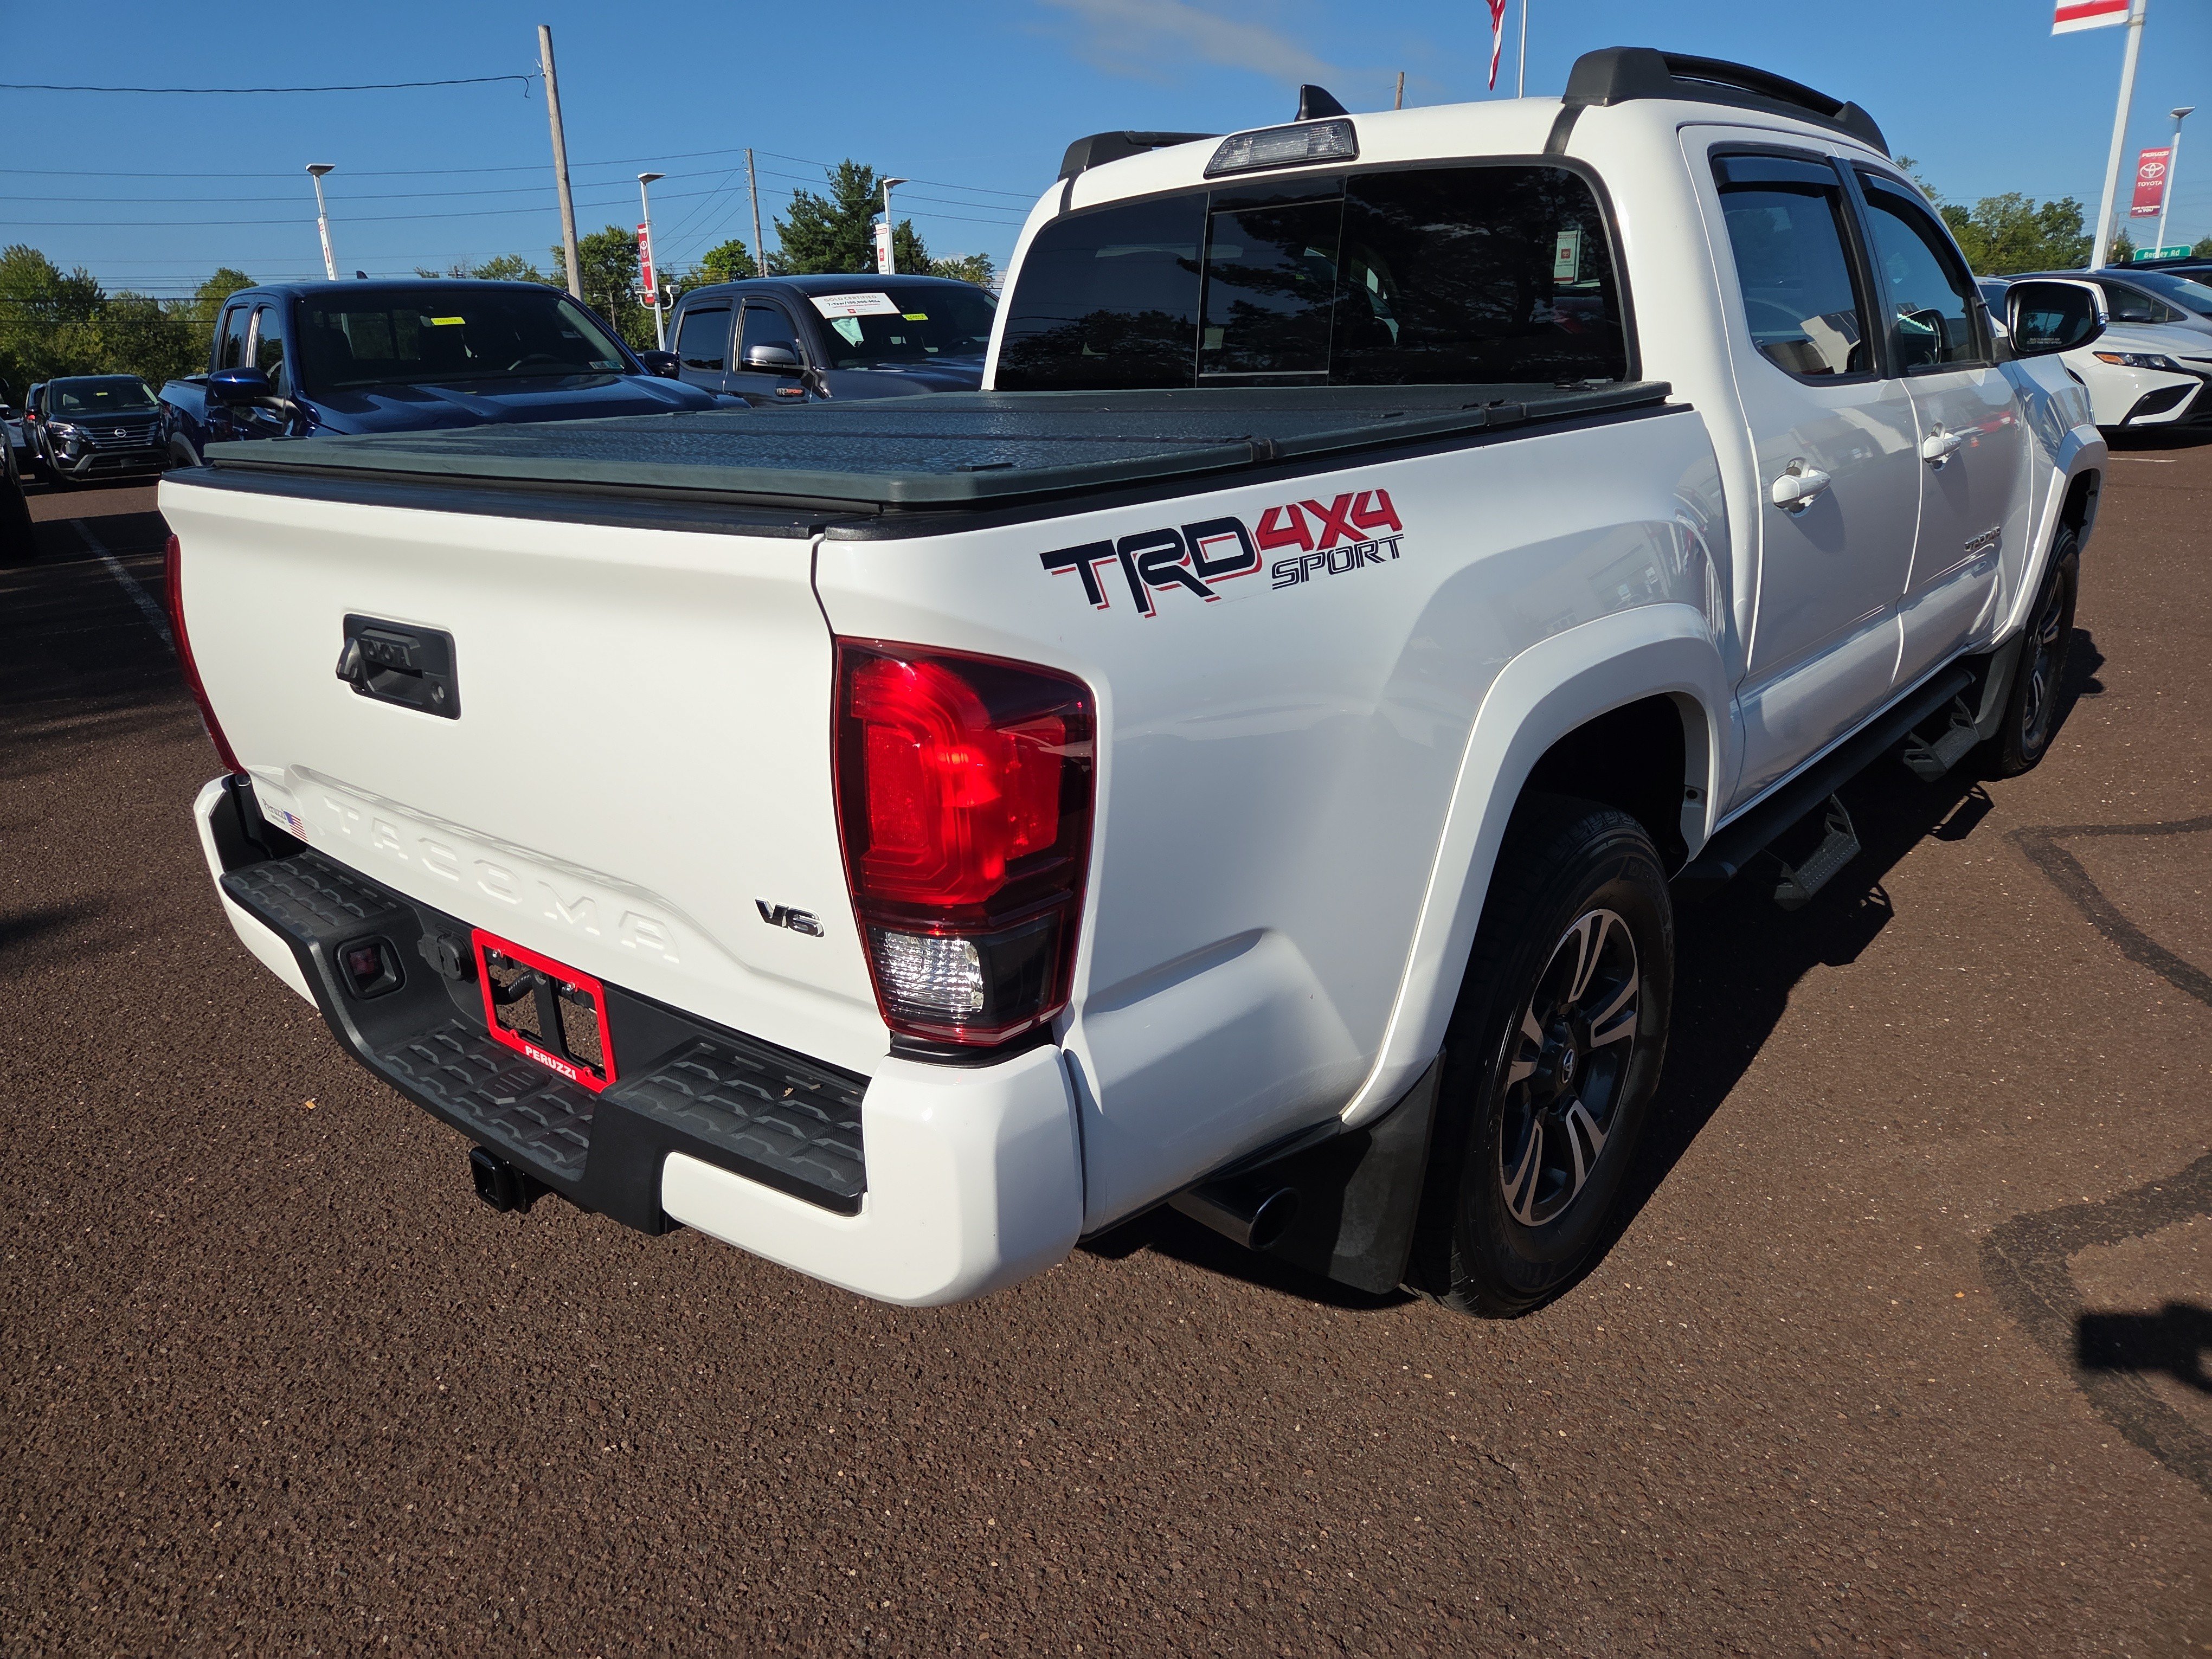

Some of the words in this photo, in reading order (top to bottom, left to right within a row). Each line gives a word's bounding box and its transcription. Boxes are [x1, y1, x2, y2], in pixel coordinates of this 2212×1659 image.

[1039, 516, 1262, 619] TRD
[1271, 533, 1405, 590] SPORT
[323, 794, 680, 964] TACOMA
[755, 896, 825, 938] V6
[525, 1045, 577, 1081] PERUZZI
